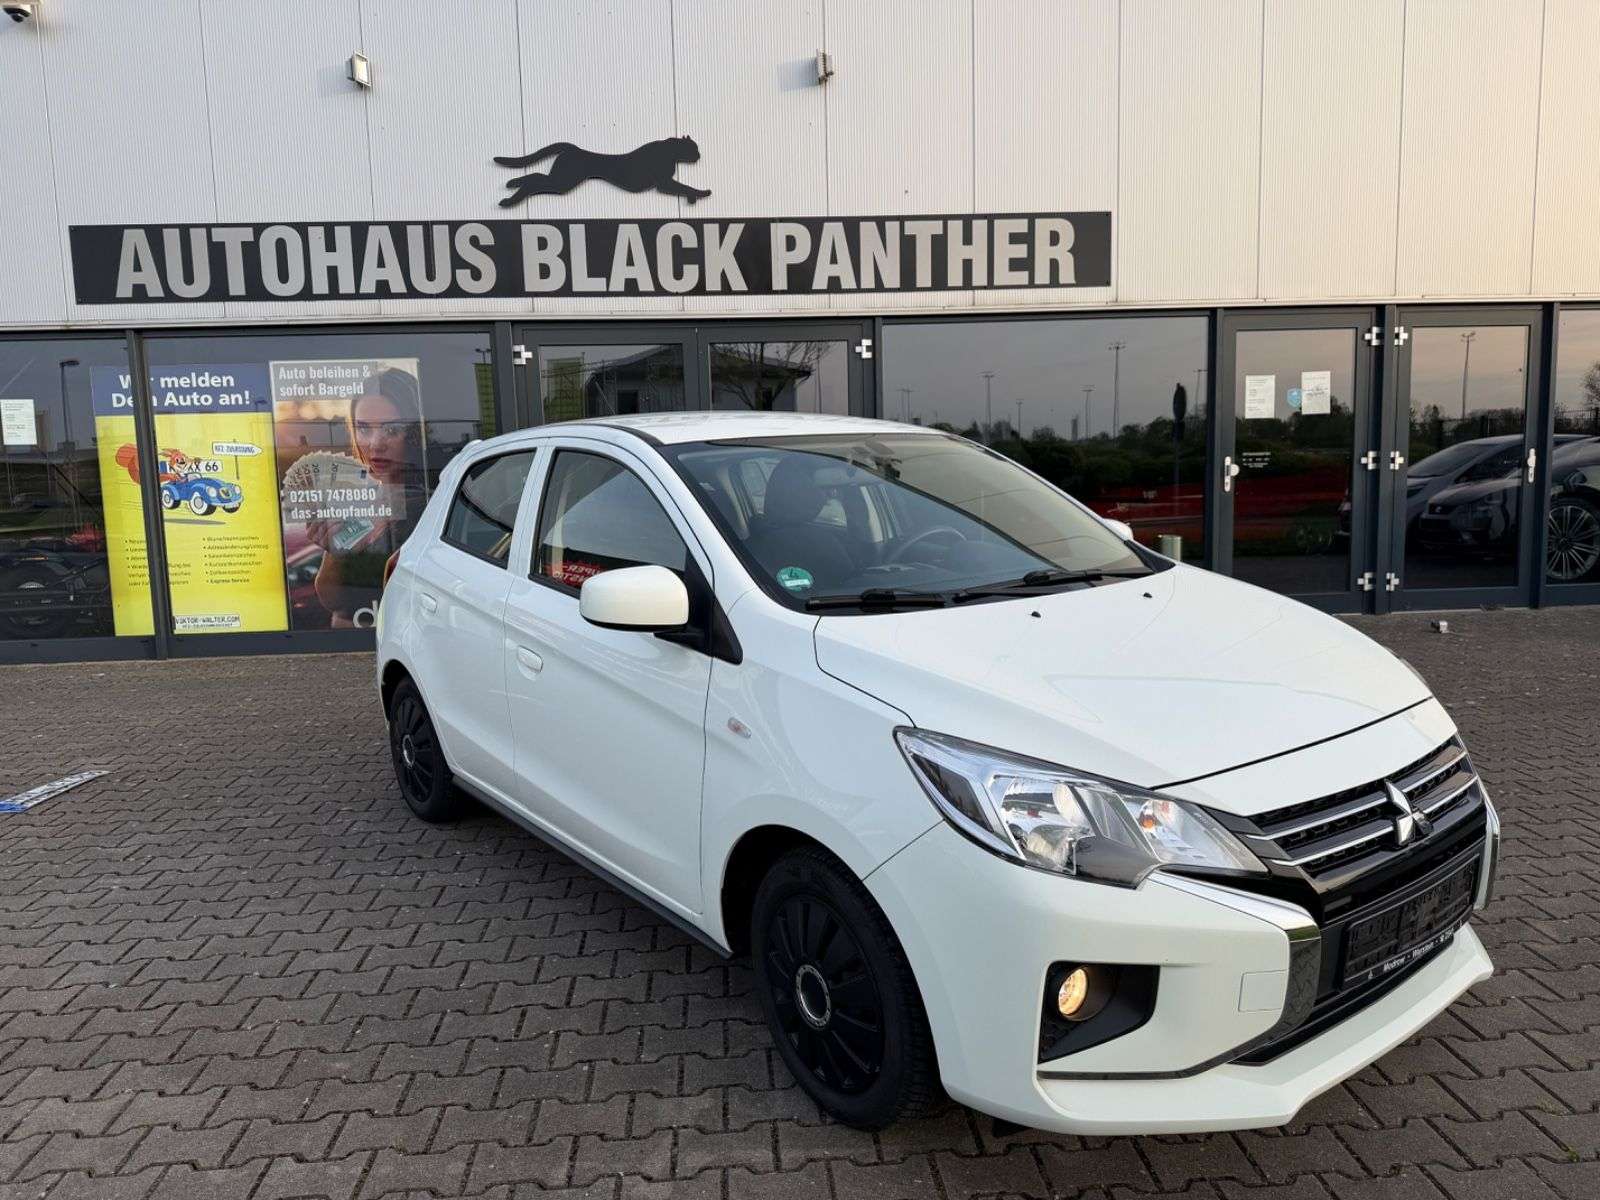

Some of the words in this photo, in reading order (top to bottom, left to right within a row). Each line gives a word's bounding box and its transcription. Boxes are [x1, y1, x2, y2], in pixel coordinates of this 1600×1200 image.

[115, 222, 498, 299] AUTOHAUS
[520, 221, 749, 293] BLACK
[771, 218, 1077, 291] PANTHER
[159, 372, 235, 388] melden
[278, 366, 307, 380] Auto
[309, 364, 360, 379] beleihen
[362, 364, 372, 378] &
[164, 391, 213, 407] Auto
[218, 389, 251, 406] an!
[279, 383, 315, 397] sofort
[318, 382, 364, 398] Bargeld
[205, 461, 219, 472] 66
[288, 489, 323, 503] 02151
[325, 487, 377, 502] 7478080
[291, 504, 393, 521] das-autopfand.de
